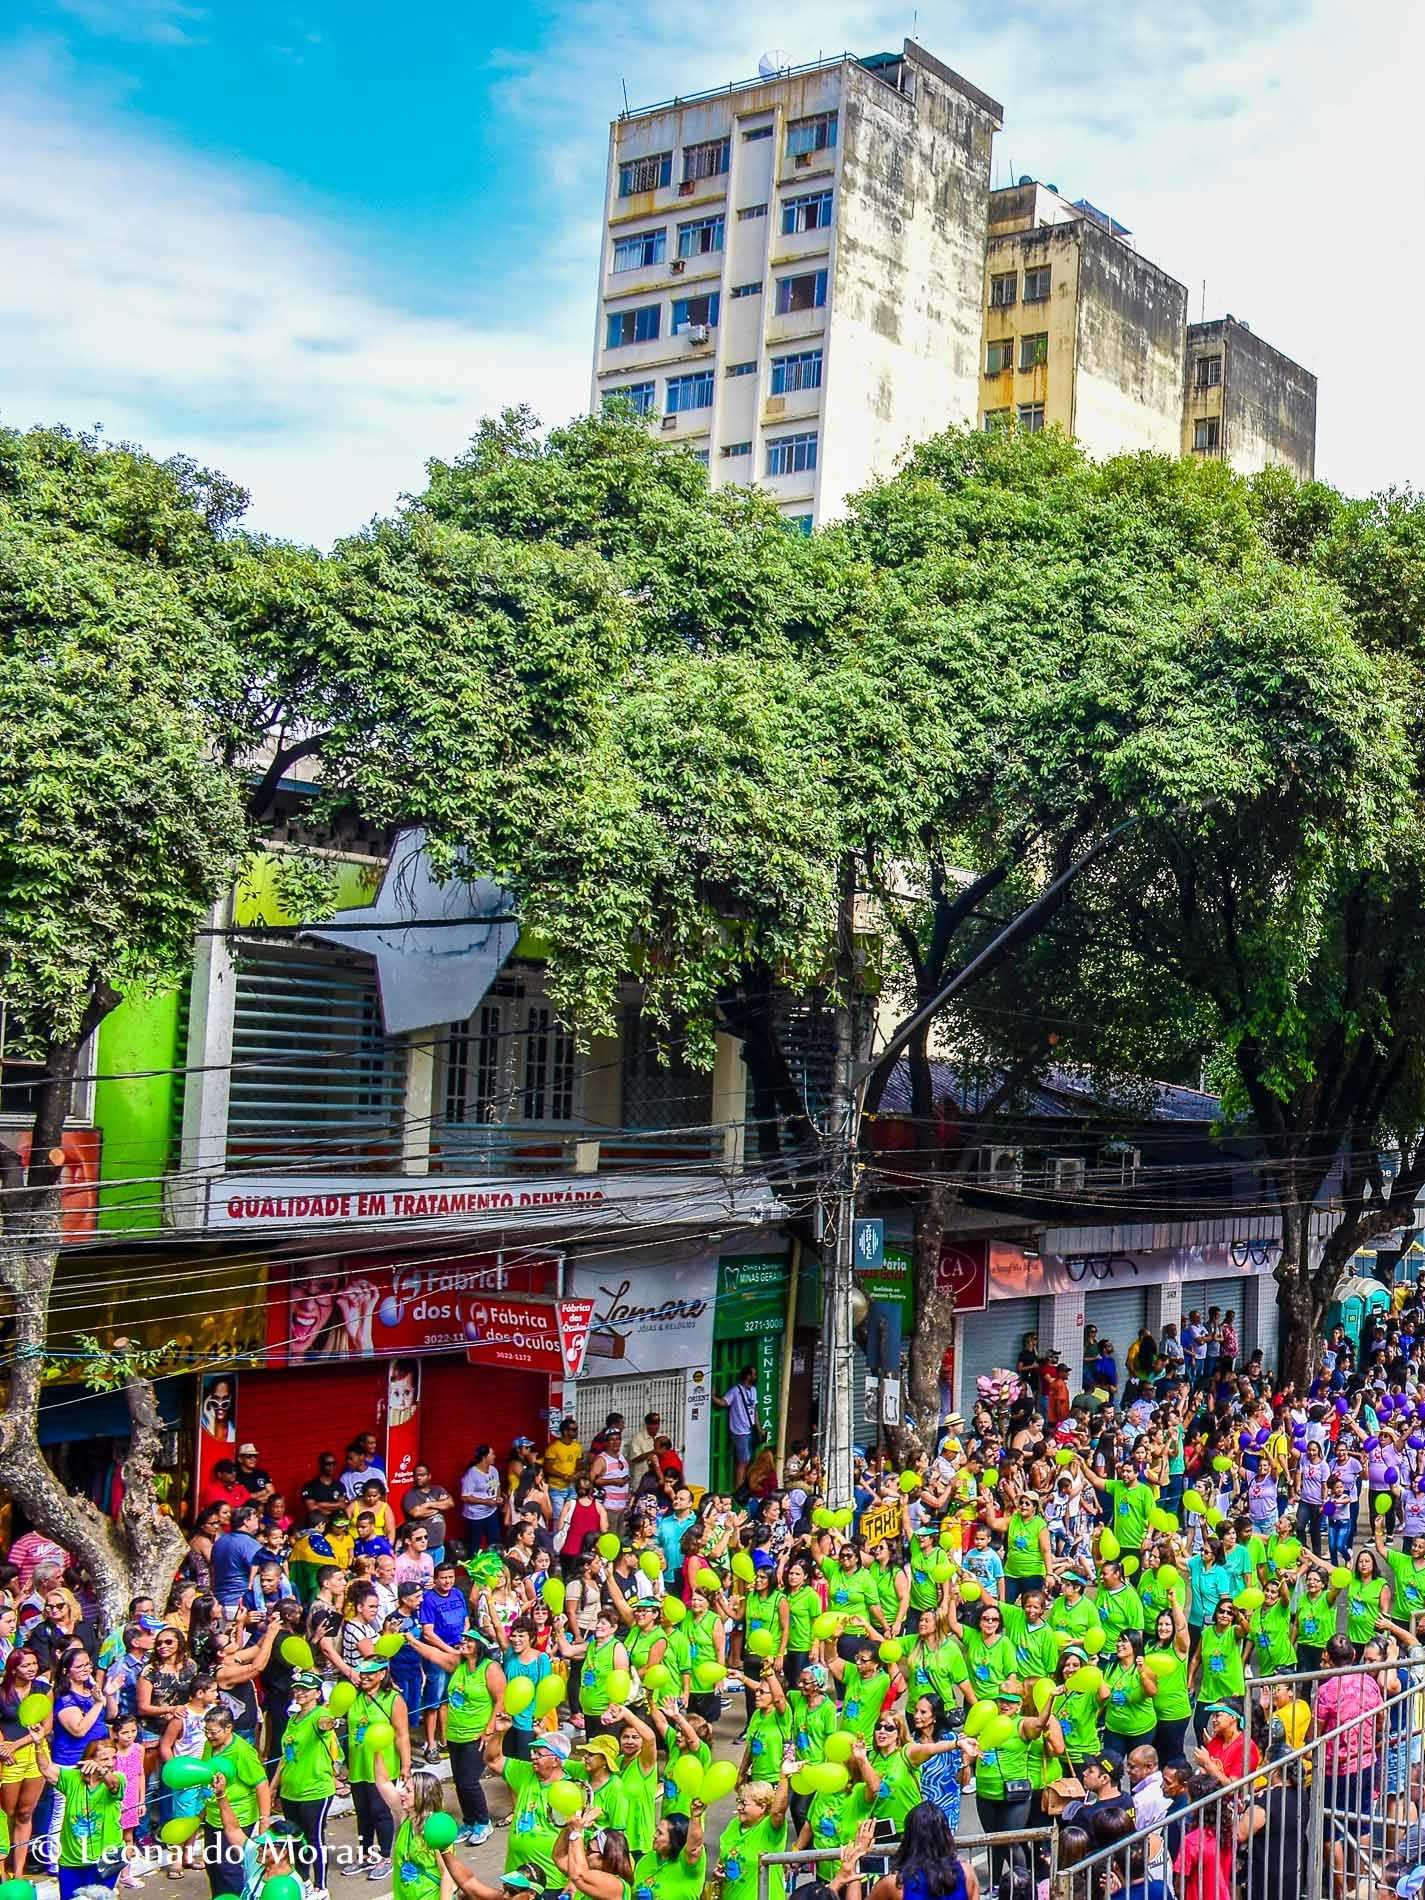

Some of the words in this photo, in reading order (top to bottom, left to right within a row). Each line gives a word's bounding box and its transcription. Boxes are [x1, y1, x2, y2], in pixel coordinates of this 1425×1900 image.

[227, 1195, 351, 1219] QUALIDADE
[357, 1193, 386, 1217] EM
[392, 1193, 514, 1216] TRATAMENTO
[412, 1300, 451, 1321] dos
[489, 1307, 548, 1329] Fábrica
[562, 1303, 591, 1312] Fábrica
[486, 1328, 510, 1343] dos
[513, 1328, 561, 1353] Óculos
